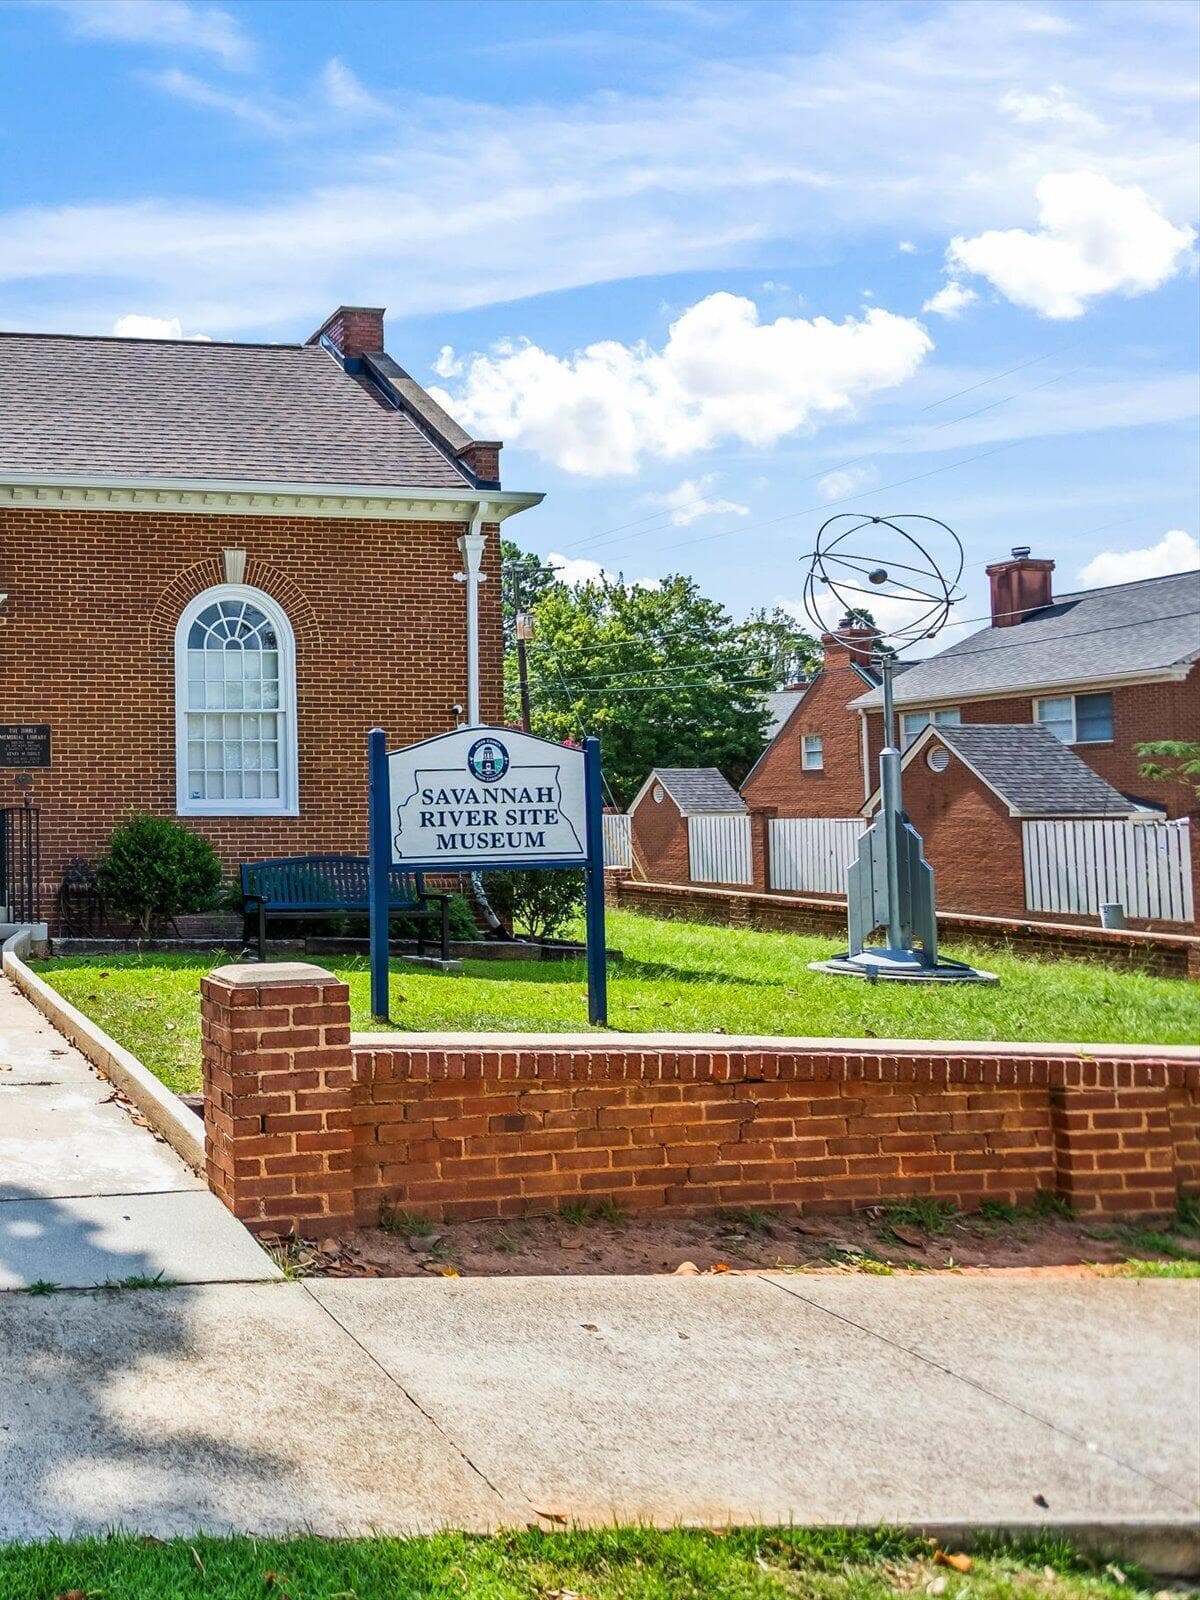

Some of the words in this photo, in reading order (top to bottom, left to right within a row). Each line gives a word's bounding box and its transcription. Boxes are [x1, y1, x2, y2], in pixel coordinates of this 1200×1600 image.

[421, 787, 555, 806] SAVANNAH
[419, 810, 499, 828] RIVER
[505, 809, 559, 826] SITE
[436, 831, 546, 850] MUSEUM
